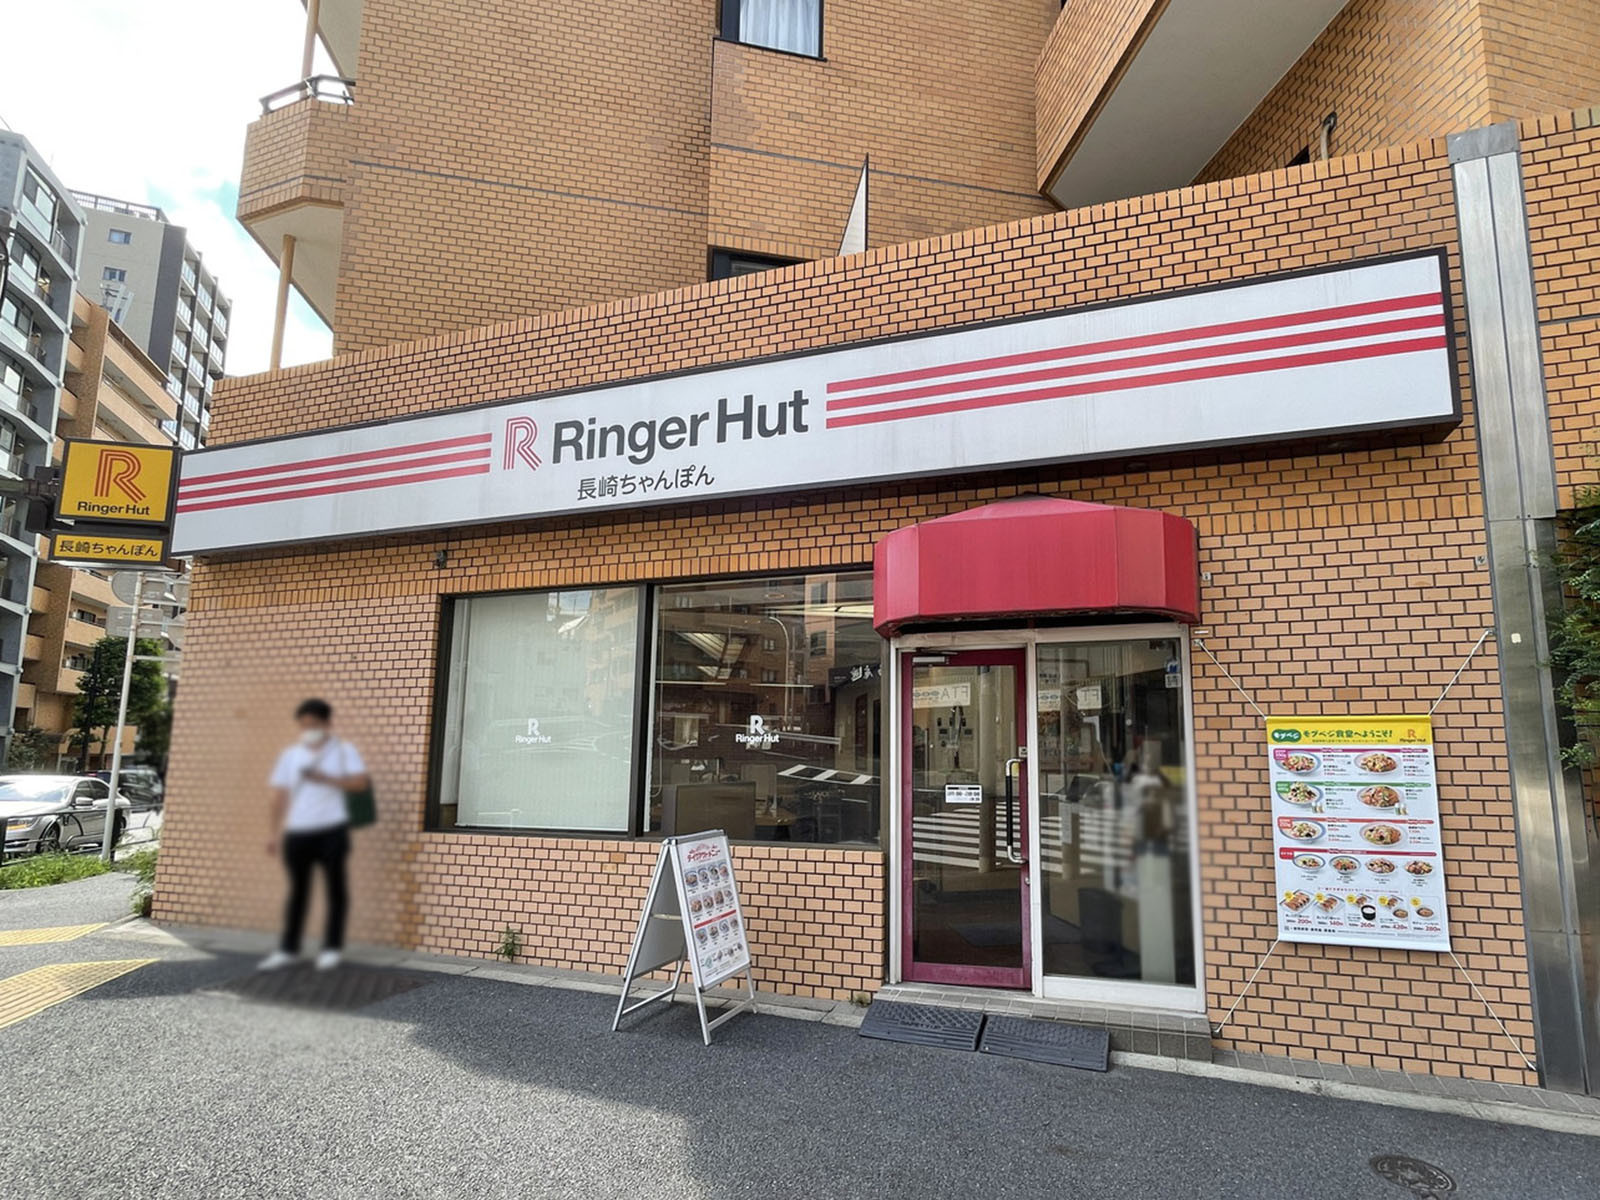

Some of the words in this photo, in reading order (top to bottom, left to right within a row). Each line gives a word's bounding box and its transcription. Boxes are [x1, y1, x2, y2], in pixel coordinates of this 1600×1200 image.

[552, 411, 710, 464] Ringer
[716, 389, 809, 443] Hut
[576, 464, 715, 501] 長崎ちゃんぽん
[76, 501, 124, 515] Ringer
[125, 504, 151, 516] Hut
[59, 540, 158, 557] 長崎ちゃんぽん
[515, 735, 538, 744] Ringer
[538, 735, 552, 743] Hut
[735, 734, 763, 744] Ringer
[763, 734, 780, 743] Hut
